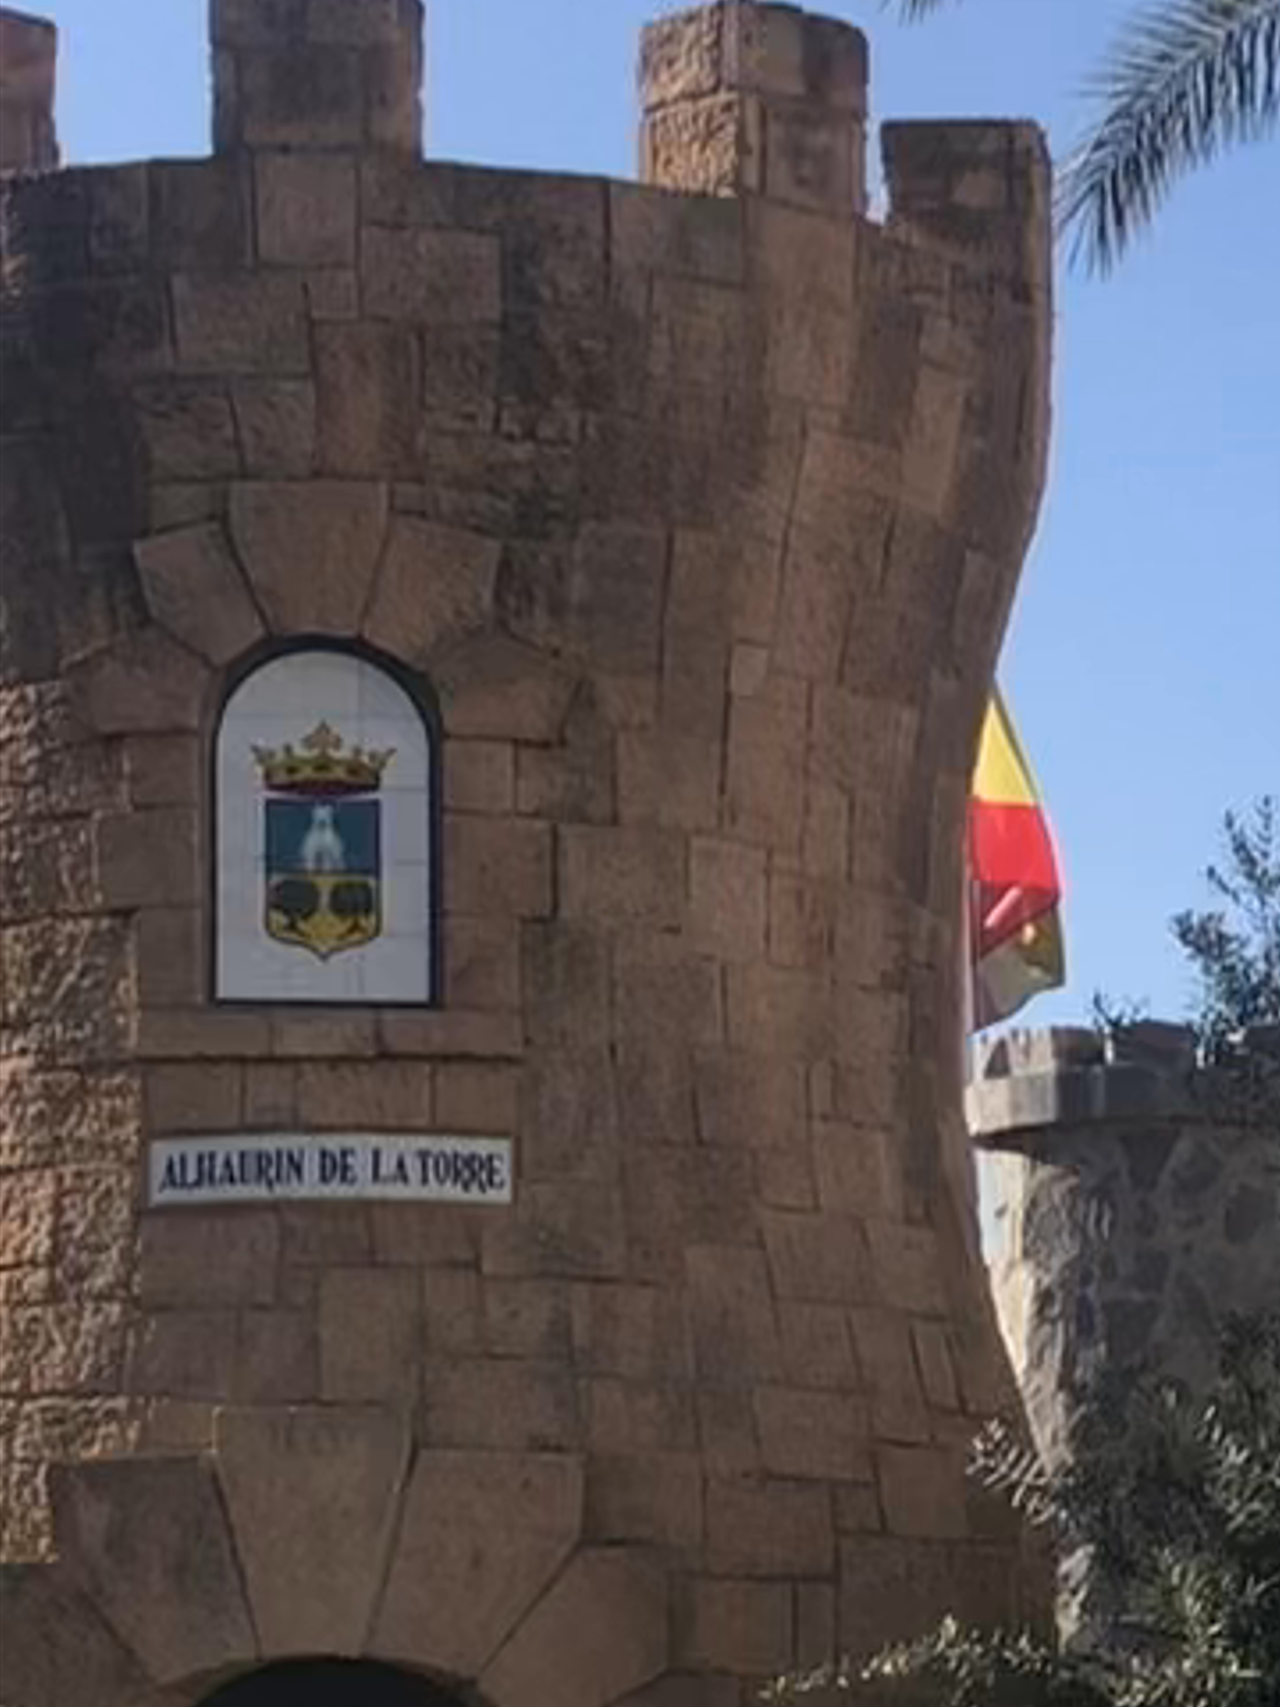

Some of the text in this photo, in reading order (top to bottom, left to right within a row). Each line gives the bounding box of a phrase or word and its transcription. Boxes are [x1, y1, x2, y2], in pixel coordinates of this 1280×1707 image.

[160, 1146, 504, 1193] ALHAURIN DE LA TORRE
